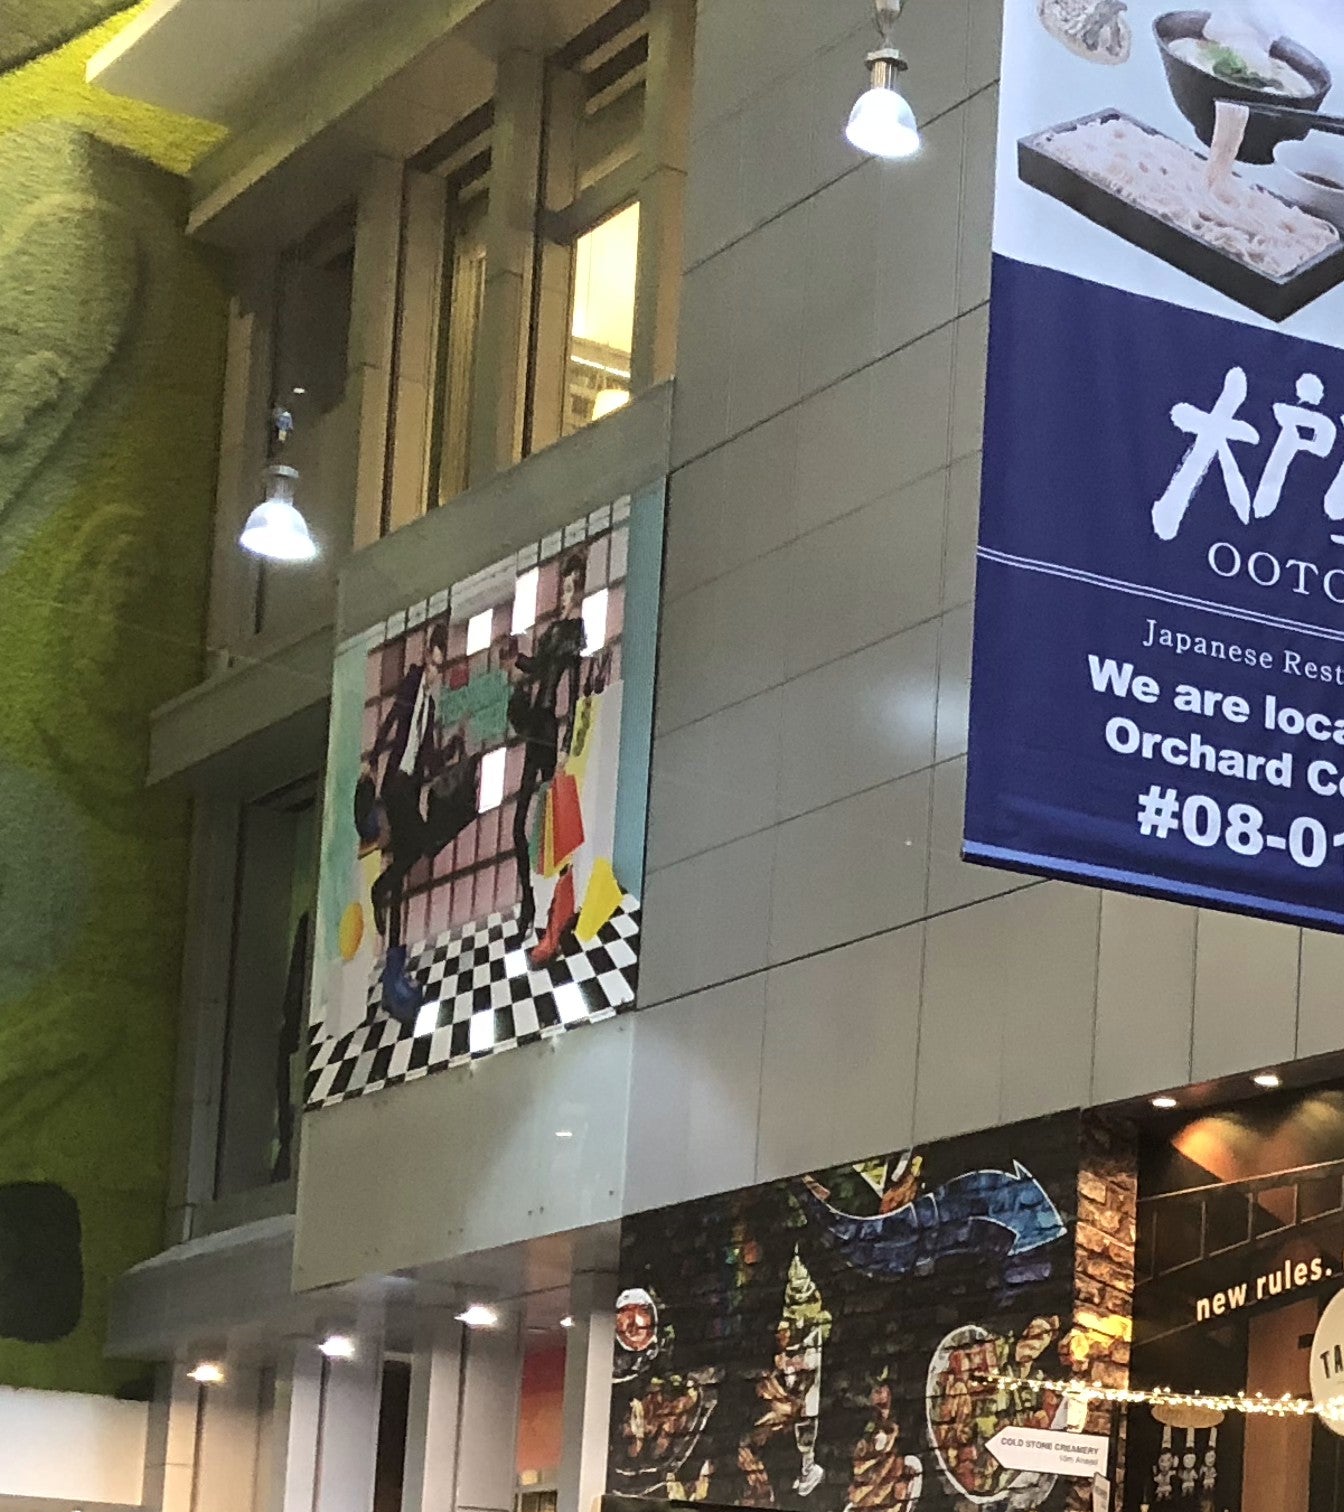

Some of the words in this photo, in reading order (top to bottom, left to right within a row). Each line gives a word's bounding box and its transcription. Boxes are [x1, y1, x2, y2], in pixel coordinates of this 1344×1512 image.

[1143, 619, 1274, 671] Japanese
[1088, 655, 1160, 703] We
[1173, 680, 1250, 725] are
[1105, 717, 1293, 789] Orchard
[1196, 1281, 1247, 1323] new
[1255, 1257, 1333, 1304] rules.
